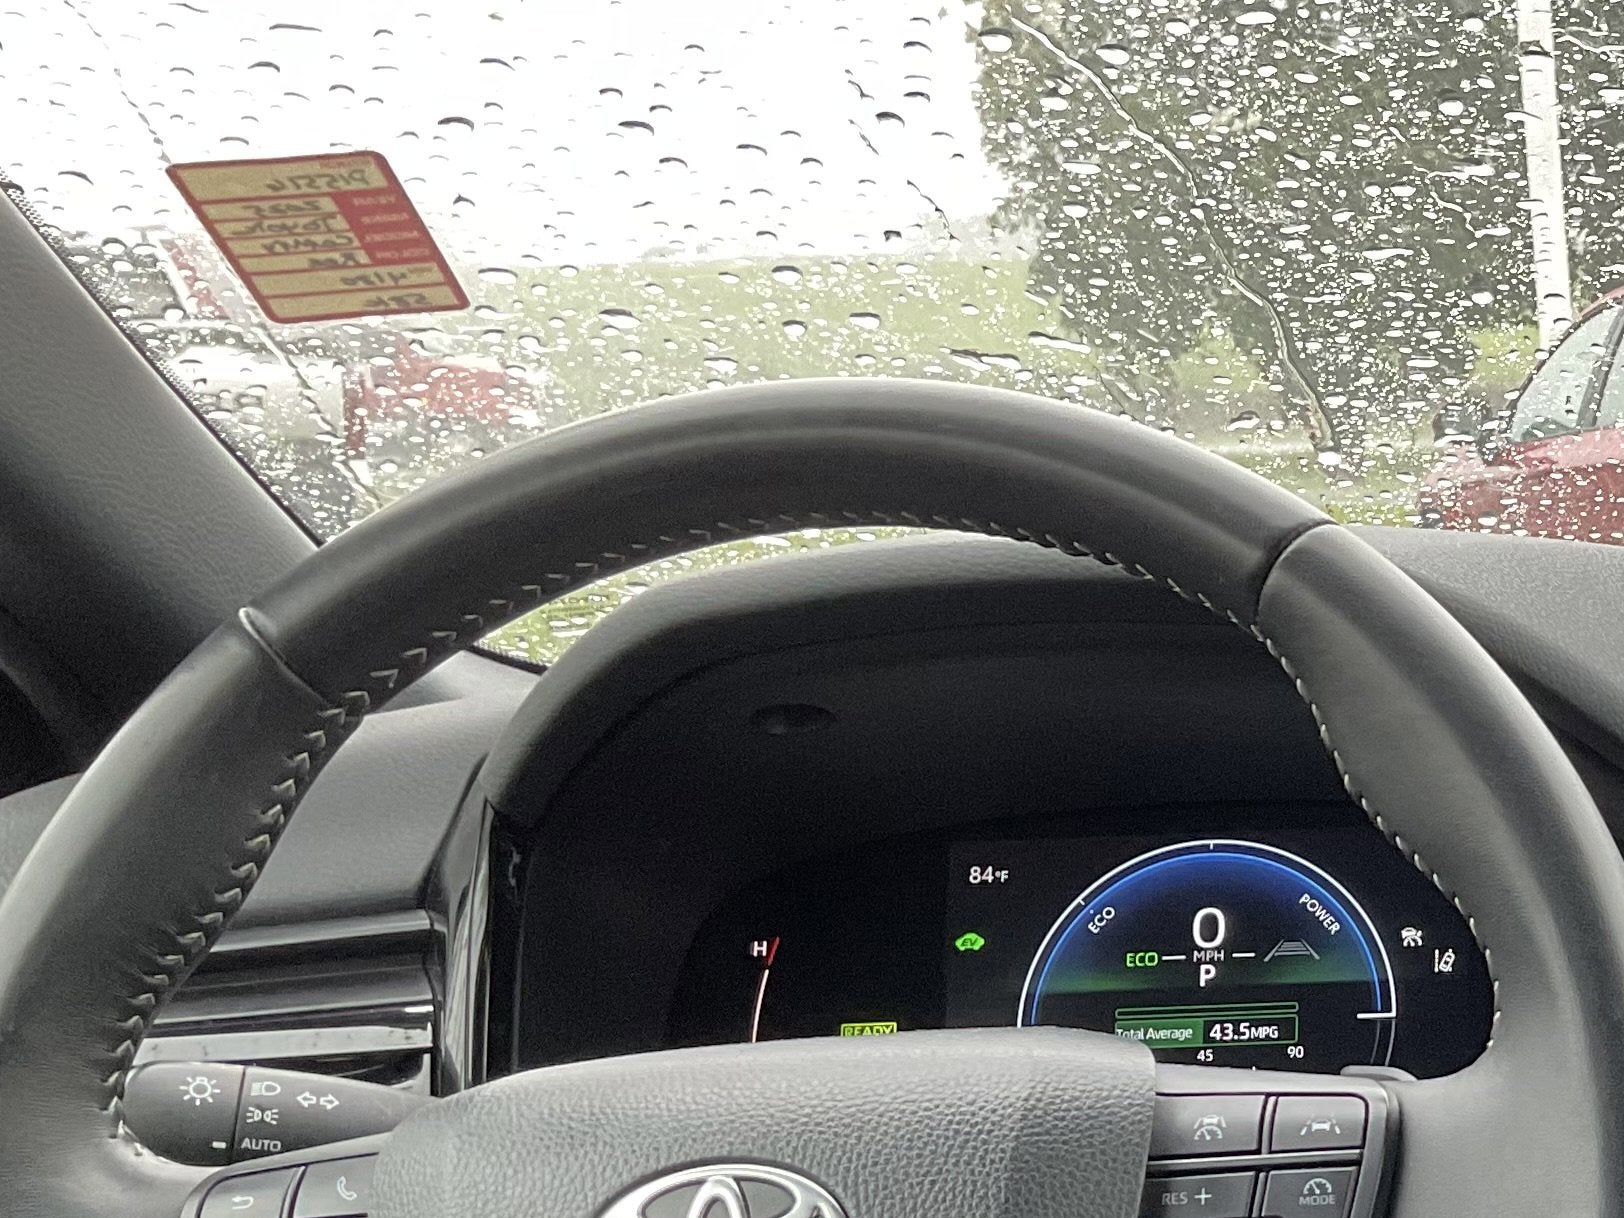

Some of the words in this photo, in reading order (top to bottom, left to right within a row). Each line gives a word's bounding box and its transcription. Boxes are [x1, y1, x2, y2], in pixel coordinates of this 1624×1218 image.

[1088, 906, 1116, 934] ECO
[1298, 893, 1341, 935] POWER
[1192, 906, 1226, 949] 0
[753, 940, 767, 957] H
[961, 937, 978, 946] EV
[1126, 951, 1159, 967] ECO
[1193, 950, 1225, 962] MPH
[1199, 964, 1216, 987] P
[844, 1024, 893, 1036] READY
[1116, 1027, 1144, 1040] Total
[1146, 1027, 1193, 1041] Average
[1196, 1049, 1214, 1062] 45
[1287, 1046, 1305, 1058] 90
[241, 1137, 282, 1152] AUTO
[1162, 1191, 1189, 1206] RES
[1299, 1194, 1336, 1206] MODE
